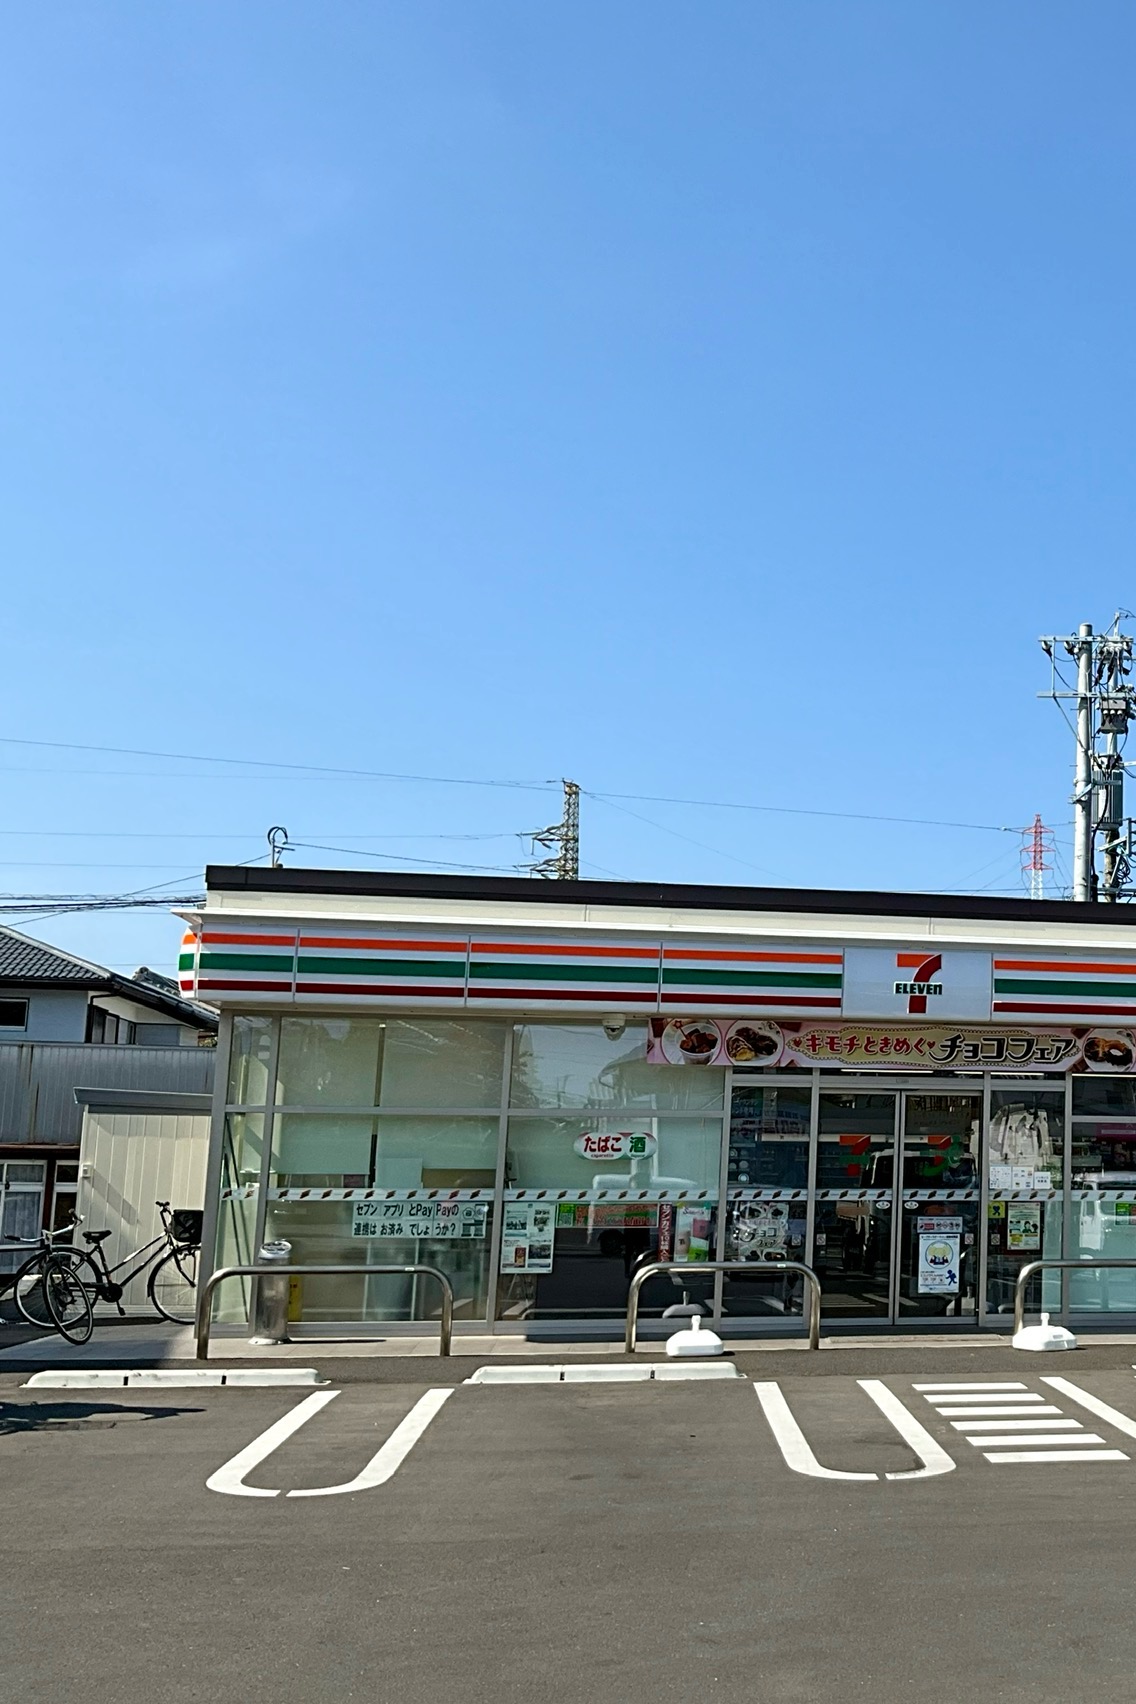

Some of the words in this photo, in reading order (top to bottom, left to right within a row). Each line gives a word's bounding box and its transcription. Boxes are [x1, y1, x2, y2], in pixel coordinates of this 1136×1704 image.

[805, 1034, 927, 1056] キモチときめく
[928, 1033, 1075, 1064] チョコフェア
[583, 1135, 623, 1153] たばこ
[629, 1136, 647, 1153] 酒
[356, 1203, 378, 1216] セブン
[383, 1204, 404, 1216] アプリ
[353, 1222, 377, 1236] 連携は
[380, 1222, 404, 1236] お済み
[409, 1223, 430, 1236] でしょ
